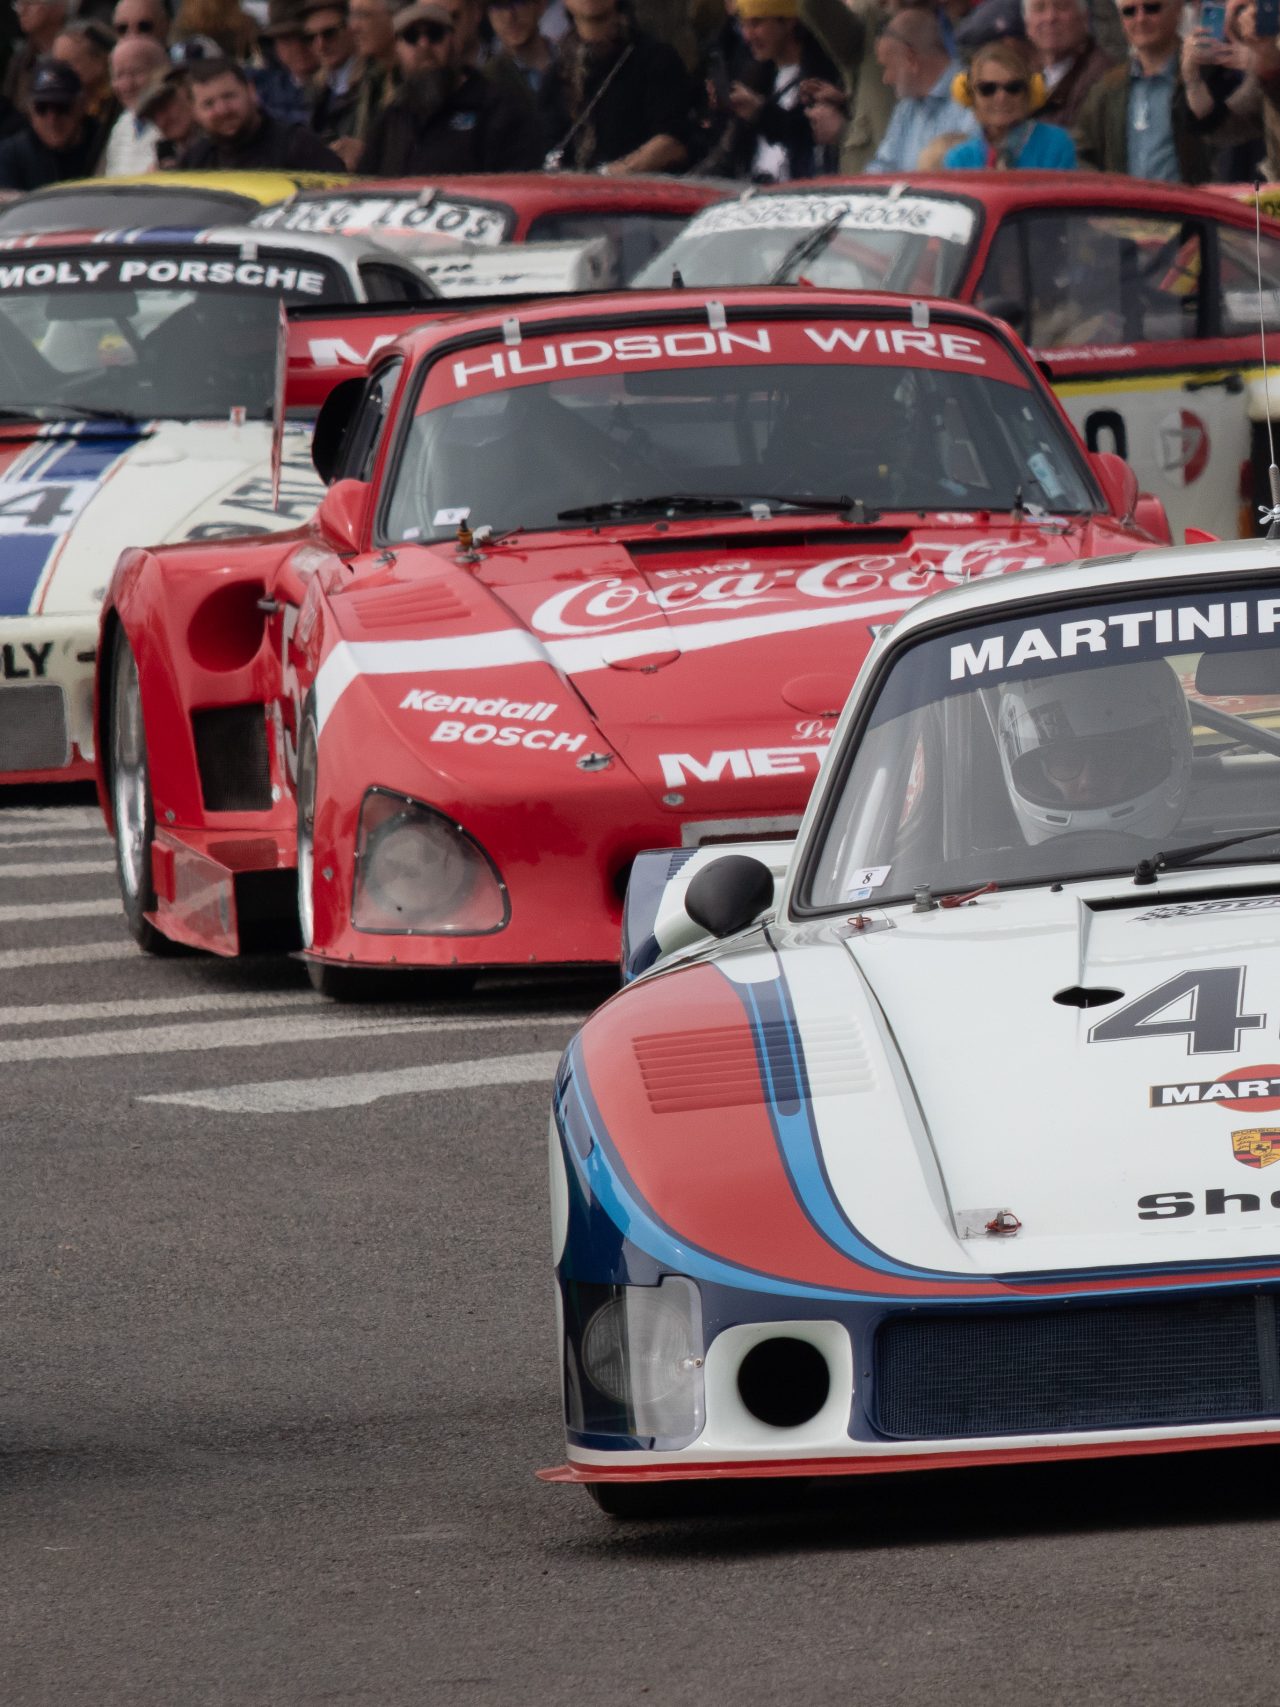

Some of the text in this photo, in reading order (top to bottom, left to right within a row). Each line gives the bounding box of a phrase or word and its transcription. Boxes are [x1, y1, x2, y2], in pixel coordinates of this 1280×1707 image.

[119, 261, 325, 295] PORSCHE
[453, 327, 986, 388] HUDSON WIRE
[533, 539, 1046, 635] Coca-Cola
[655, 561, 751, 579] Enjoy
[399, 688, 558, 722] Kendall
[430, 720, 588, 752] BOSCH
